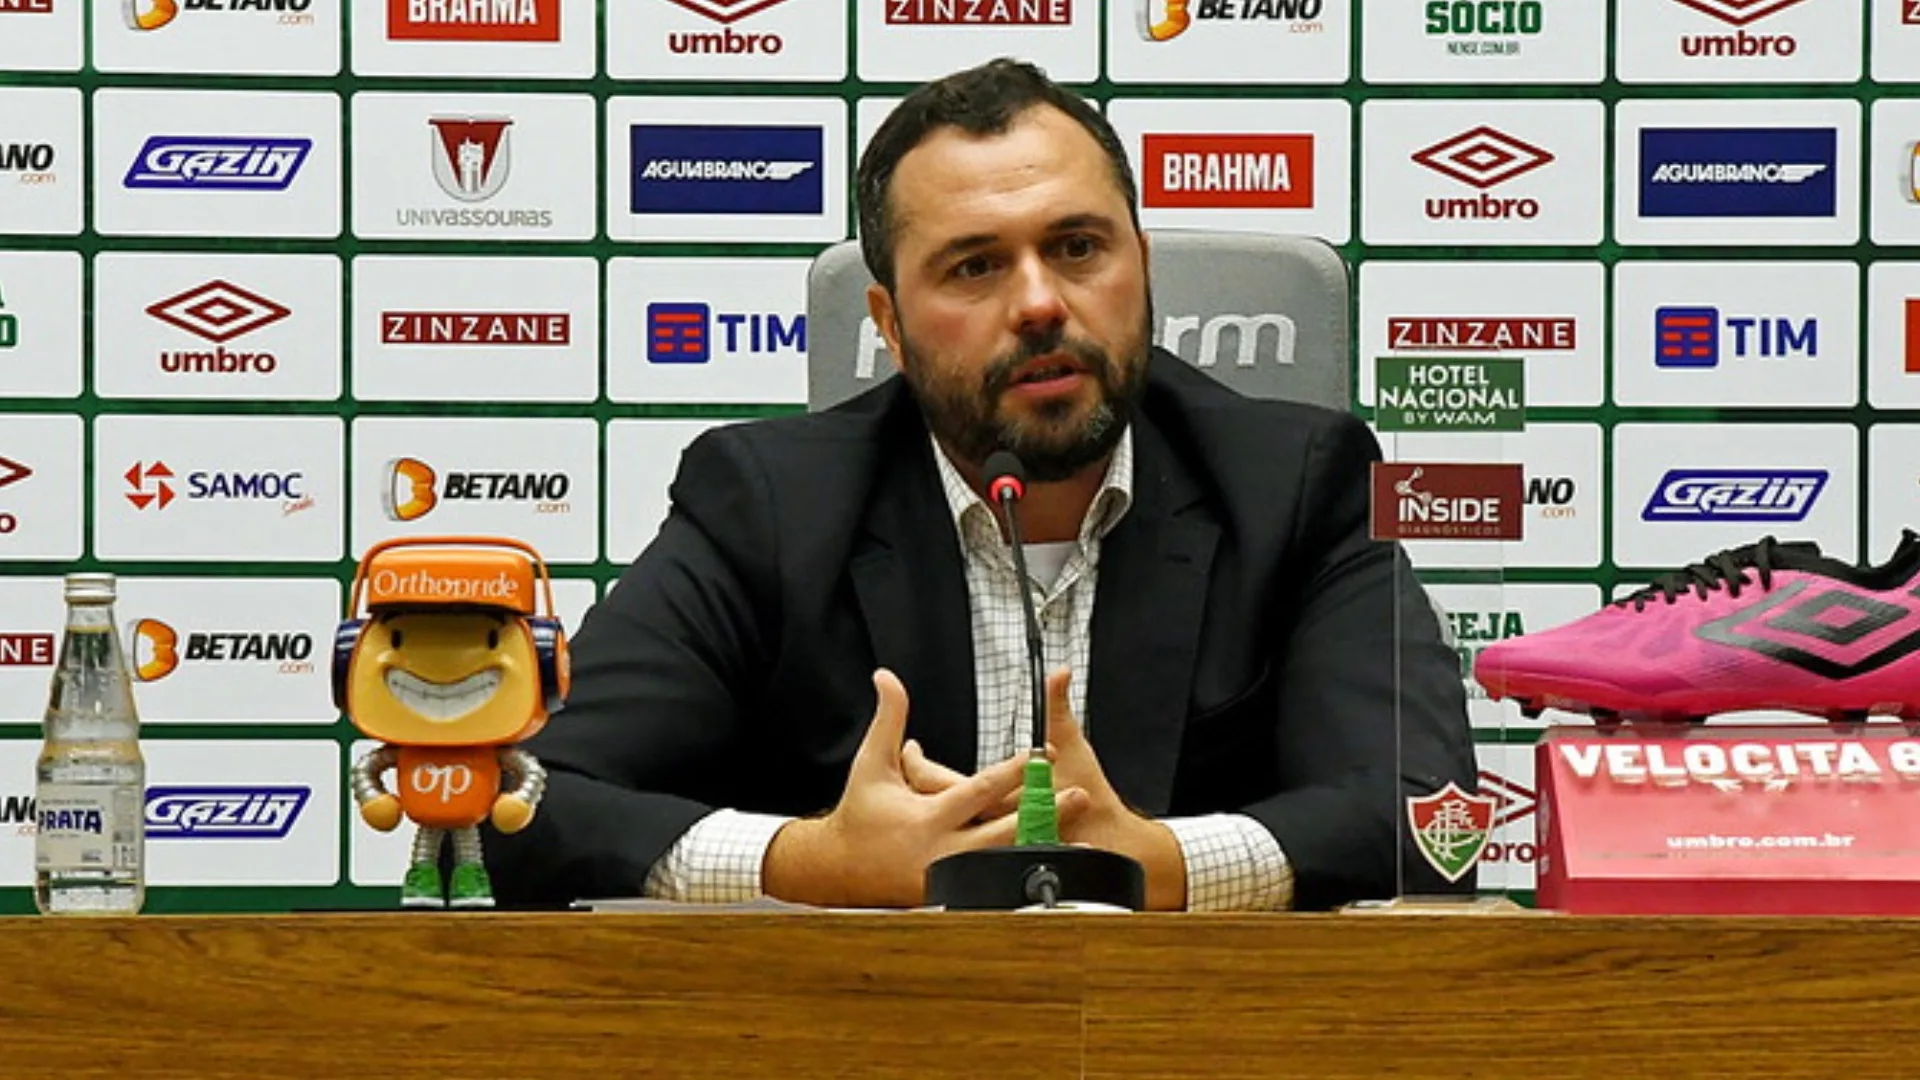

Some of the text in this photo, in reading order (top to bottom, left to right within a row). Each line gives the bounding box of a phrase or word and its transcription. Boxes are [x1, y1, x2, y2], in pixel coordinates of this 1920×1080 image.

[408, 0, 538, 24] BRAHMA
[890, 0, 1065, 21] ZINZANE
[668, 27, 783, 54] umbro
[1681, 29, 1797, 56] umbro
[146, 144, 300, 180] GAZIN
[1162, 153, 1292, 191] BRAHMA
[1425, 192, 1539, 219] umbro
[387, 316, 565, 342] ZINZANE
[717, 313, 807, 352] TIM
[1393, 322, 1571, 347] ZINZANE
[1726, 318, 1817, 356] TIM
[160, 346, 276, 373] umbro
[1409, 364, 1490, 386] HOTEL
[1378, 386, 1520, 410] NACIONAL
[1403, 411, 1497, 424] BY WAM
[187, 472, 303, 499] SAMOC
[443, 473, 569, 500] BETANO
[1662, 477, 1816, 514] GAZIN
[1398, 498, 1501, 522] INSIDE
[373, 569, 519, 599] Orthopride
[185, 633, 312, 660] BETANO
[1559, 741, 1881, 778] VELOCITA
[411, 763, 473, 803] op
[38, 810, 102, 834] PRATA
[145, 795, 298, 830] GAZIN
[1666, 833, 1855, 849] umbro.com.br
